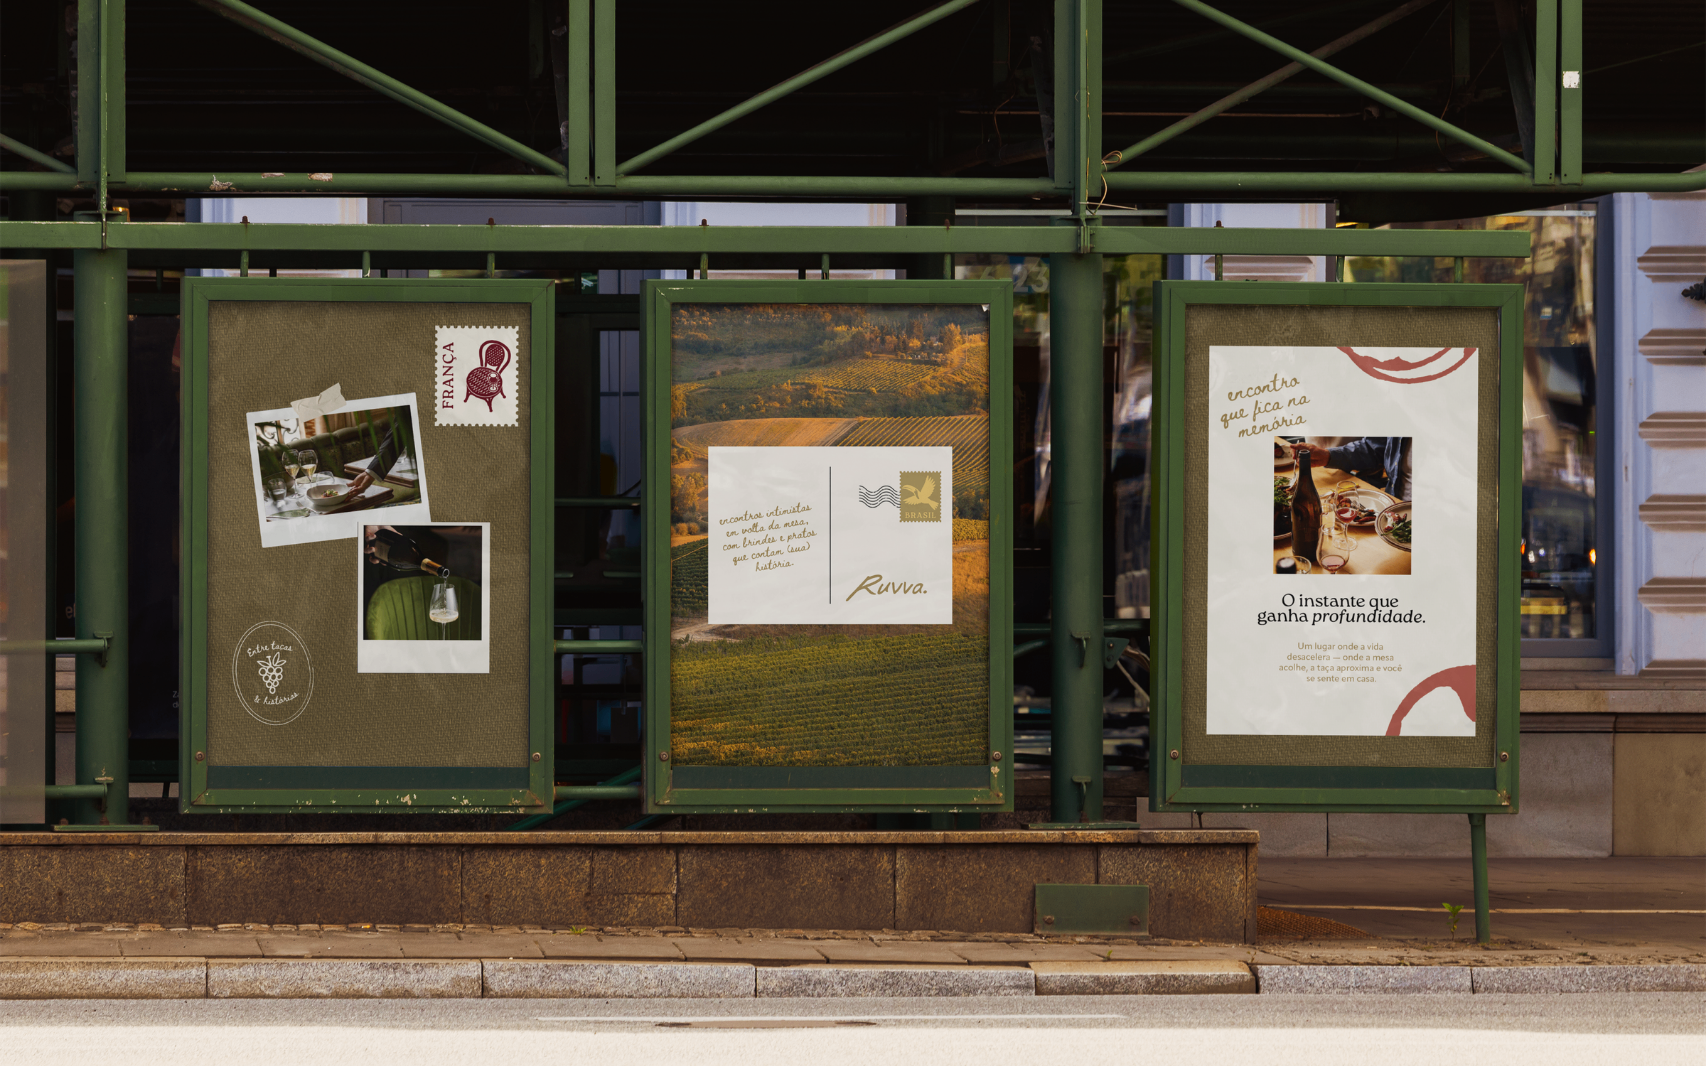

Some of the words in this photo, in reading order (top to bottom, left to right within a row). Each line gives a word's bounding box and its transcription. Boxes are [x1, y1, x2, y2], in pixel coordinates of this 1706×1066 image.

[442, 342, 457, 409] FRANÇA
[1228, 373, 1300, 401] encontro
[1220, 408, 1248, 429] que
[1252, 400, 1284, 422] fica
[1288, 396, 1310, 407] na
[1238, 414, 1307, 438] memória
[719, 510, 764, 525] encontros
[766, 502, 812, 517] intimistas
[742, 522, 766, 534] volta
[768, 520, 781, 530] da
[784, 519, 808, 528] mesa,
[723, 543, 740, 551] com
[742, 534, 777, 548] brindes
[787, 528, 817, 542] pratos
[733, 554, 748, 566] que
[751, 546, 784, 559] contam
[787, 541, 810, 553] (sua)
[756, 560, 794, 572] história.
[846, 574, 927, 602] Ruvva.
[1282, 593, 1295, 607] O
[1299, 594, 1366, 607] instante
[1369, 597, 1399, 610] que
[1257, 609, 1309, 626] ganha
[1312, 609, 1426, 626] profundidade.
[247, 644, 269, 657] Entre
[1314, 642, 1336, 652] lugar
[1279, 664, 1309, 673] acolhe,
[1317, 664, 1335, 673] taça
[1336, 664, 1374, 673] aproxima
